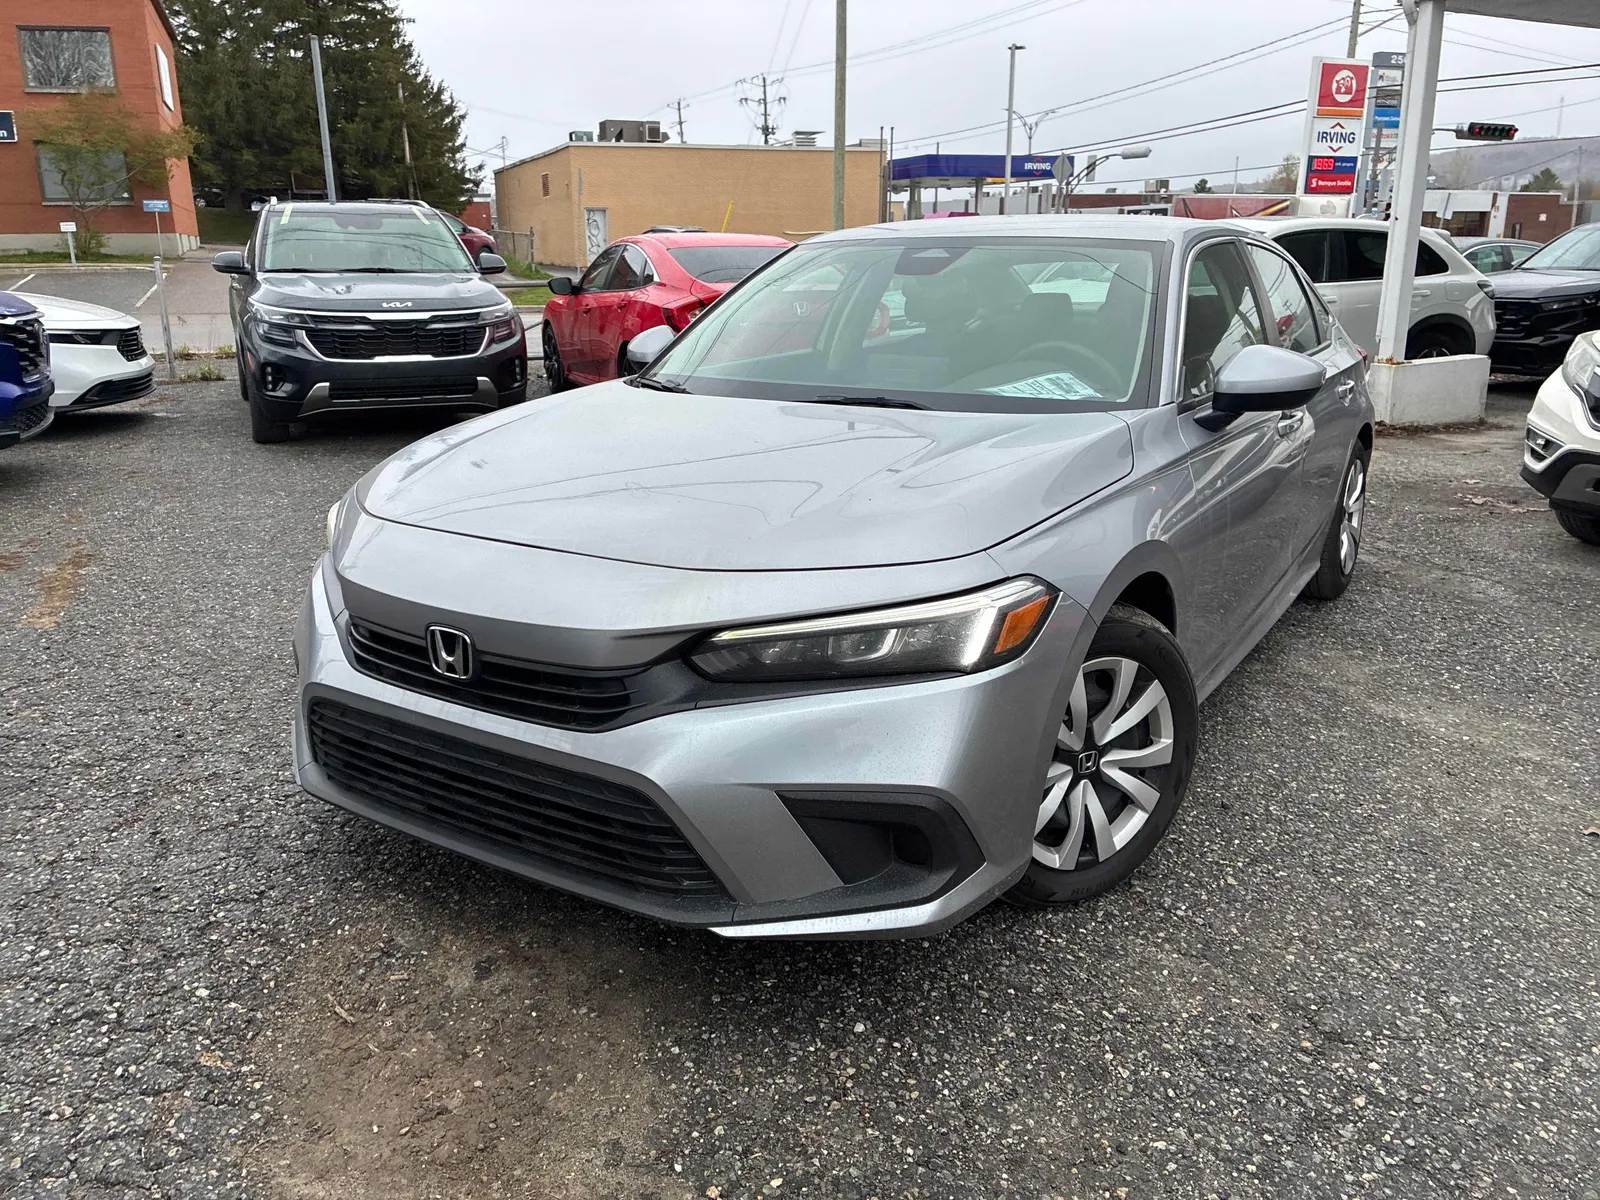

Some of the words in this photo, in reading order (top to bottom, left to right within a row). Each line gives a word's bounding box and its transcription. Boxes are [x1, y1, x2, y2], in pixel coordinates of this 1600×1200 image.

[1391, 55, 1406, 64] 25
[1317, 131, 1356, 143] IRVING
[1024, 162, 1051, 170] IRVING
